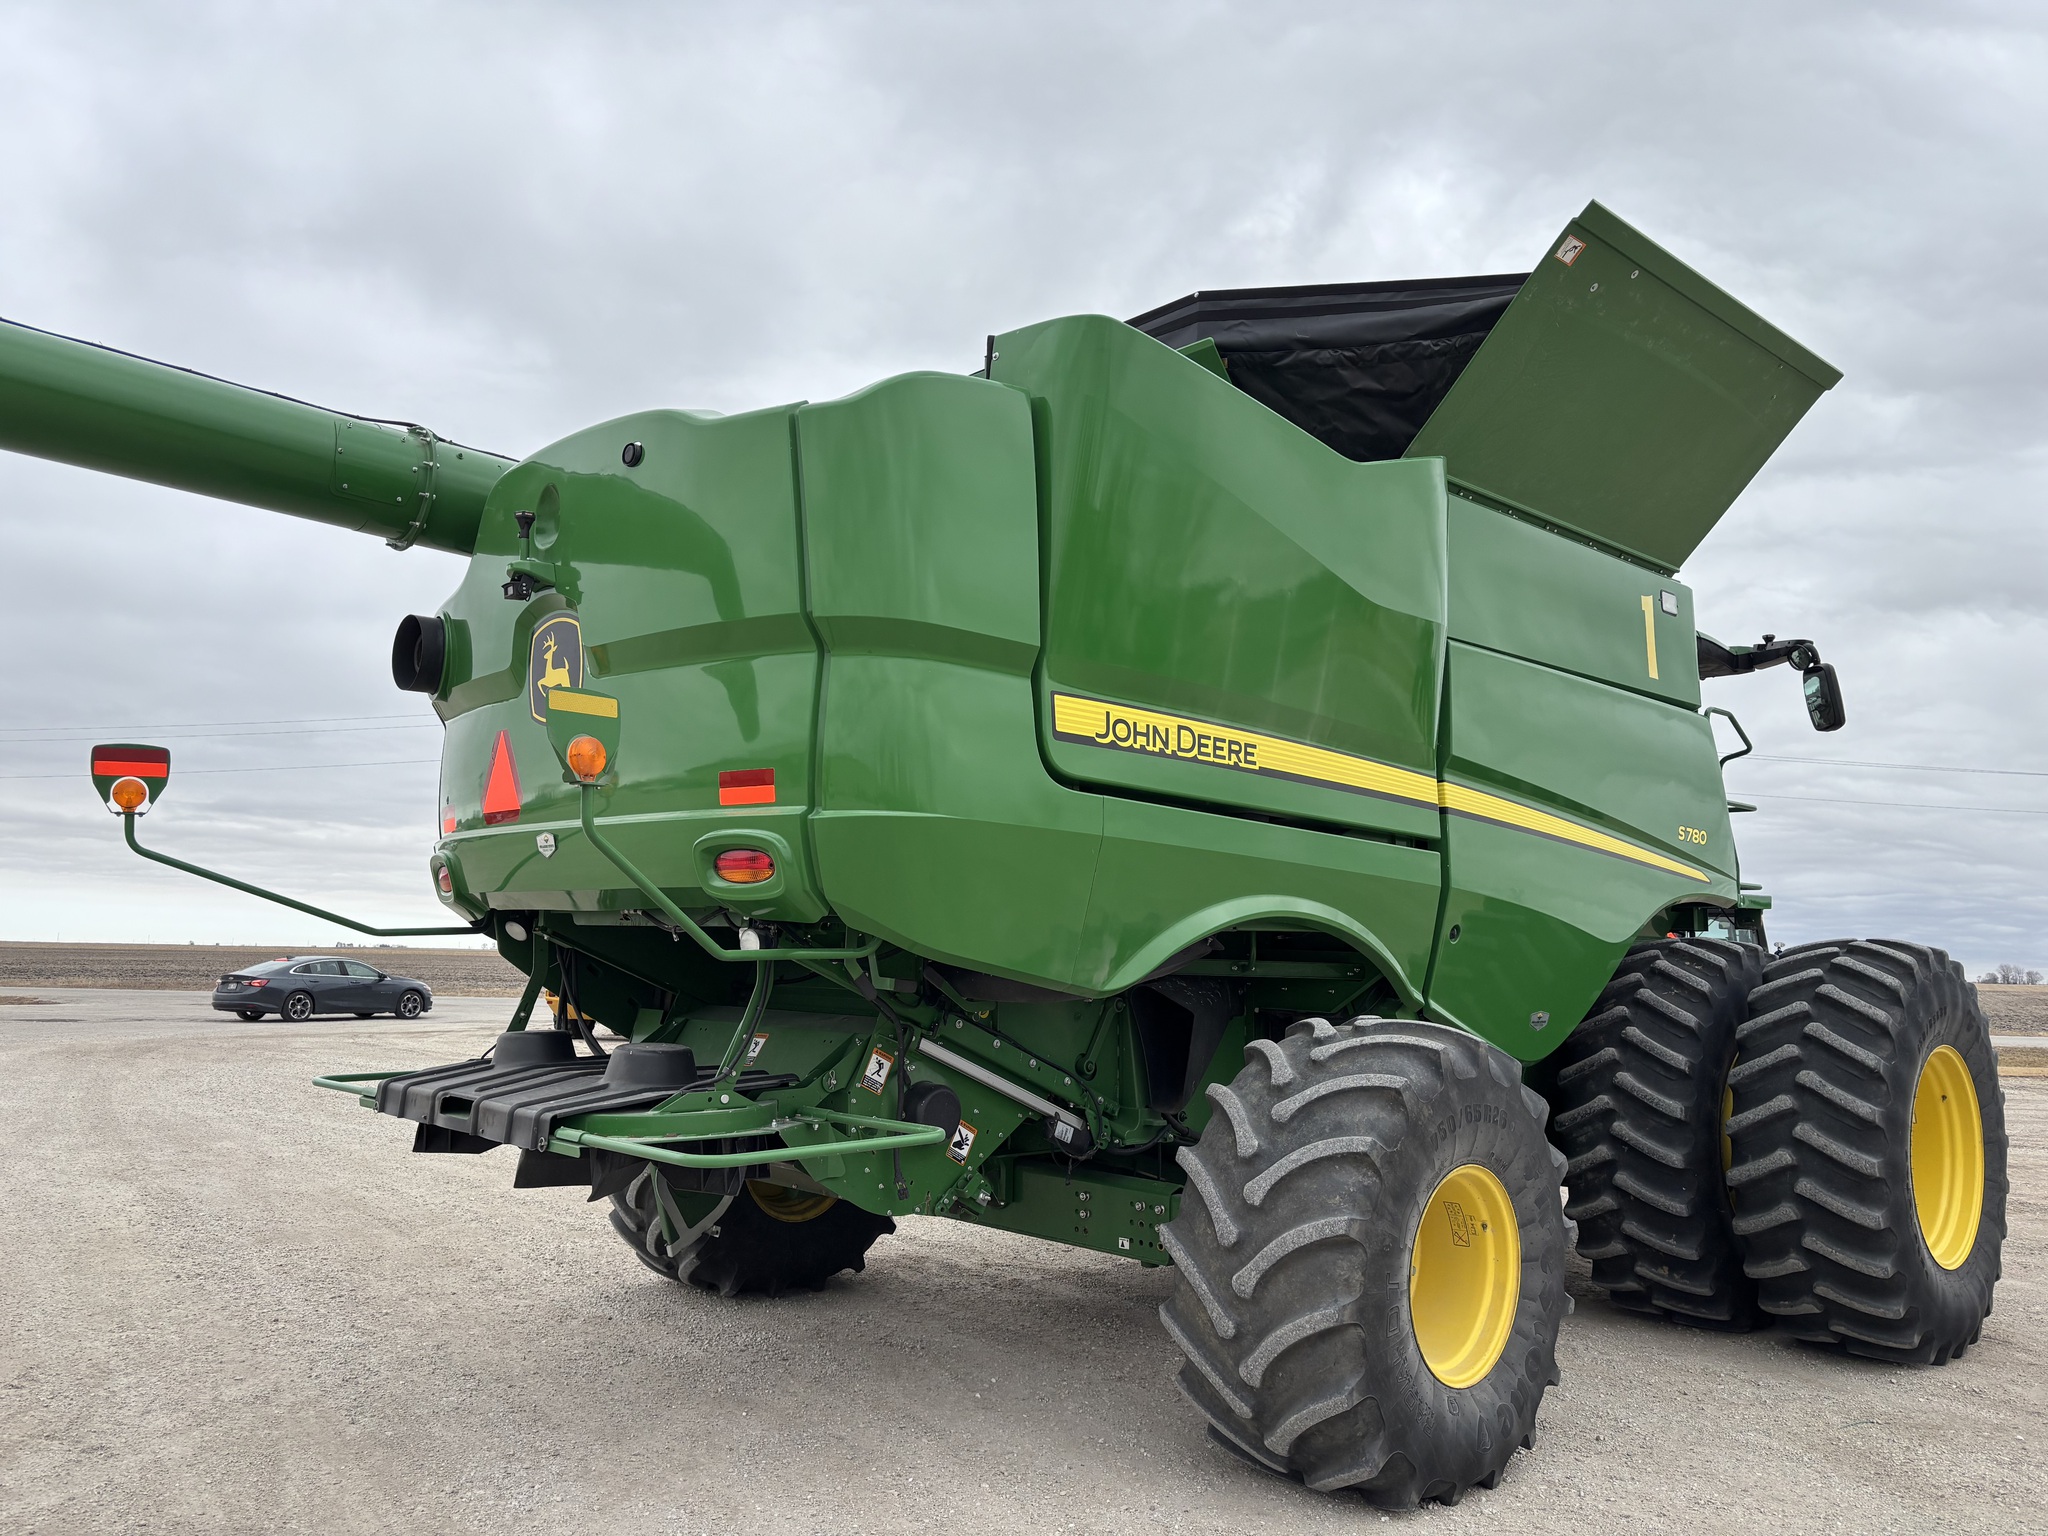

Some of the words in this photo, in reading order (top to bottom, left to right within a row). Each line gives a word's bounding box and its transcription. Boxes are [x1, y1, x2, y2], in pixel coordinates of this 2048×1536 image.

[1095, 710, 1170, 751] JOHN
[1177, 724, 1258, 766] DEERE
[1678, 825, 1708, 845] S780
[1430, 1103, 1508, 1151] 750/65R26
